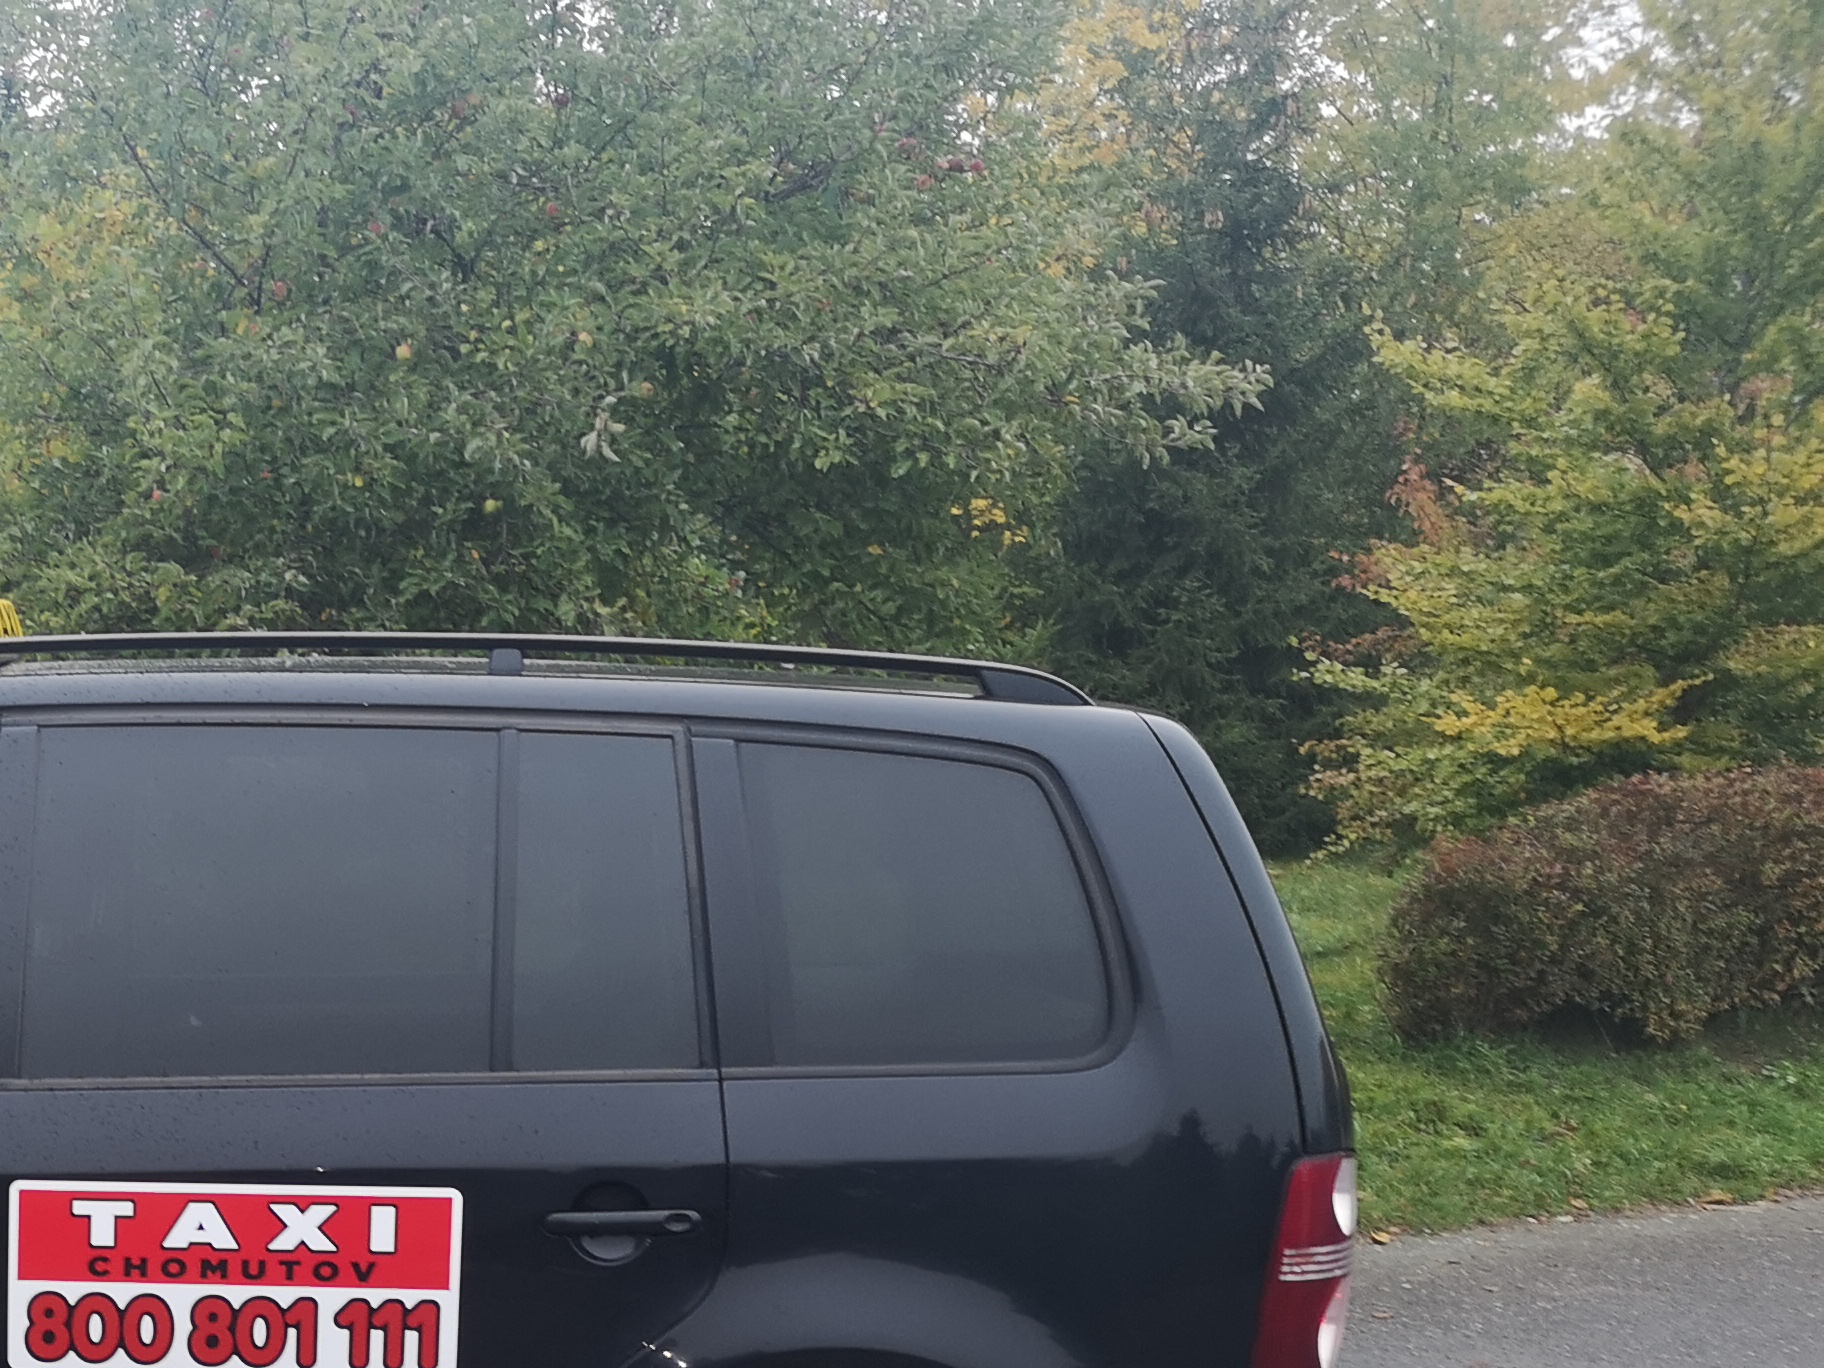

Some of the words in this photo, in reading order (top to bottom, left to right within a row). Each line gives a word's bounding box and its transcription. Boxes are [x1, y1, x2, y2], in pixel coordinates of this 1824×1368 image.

[71, 1200, 397, 1253] TAXI
[87, 1256, 377, 1282] CHOMUTOV
[25, 1291, 174, 1365] 800
[187, 1295, 318, 1368] 801
